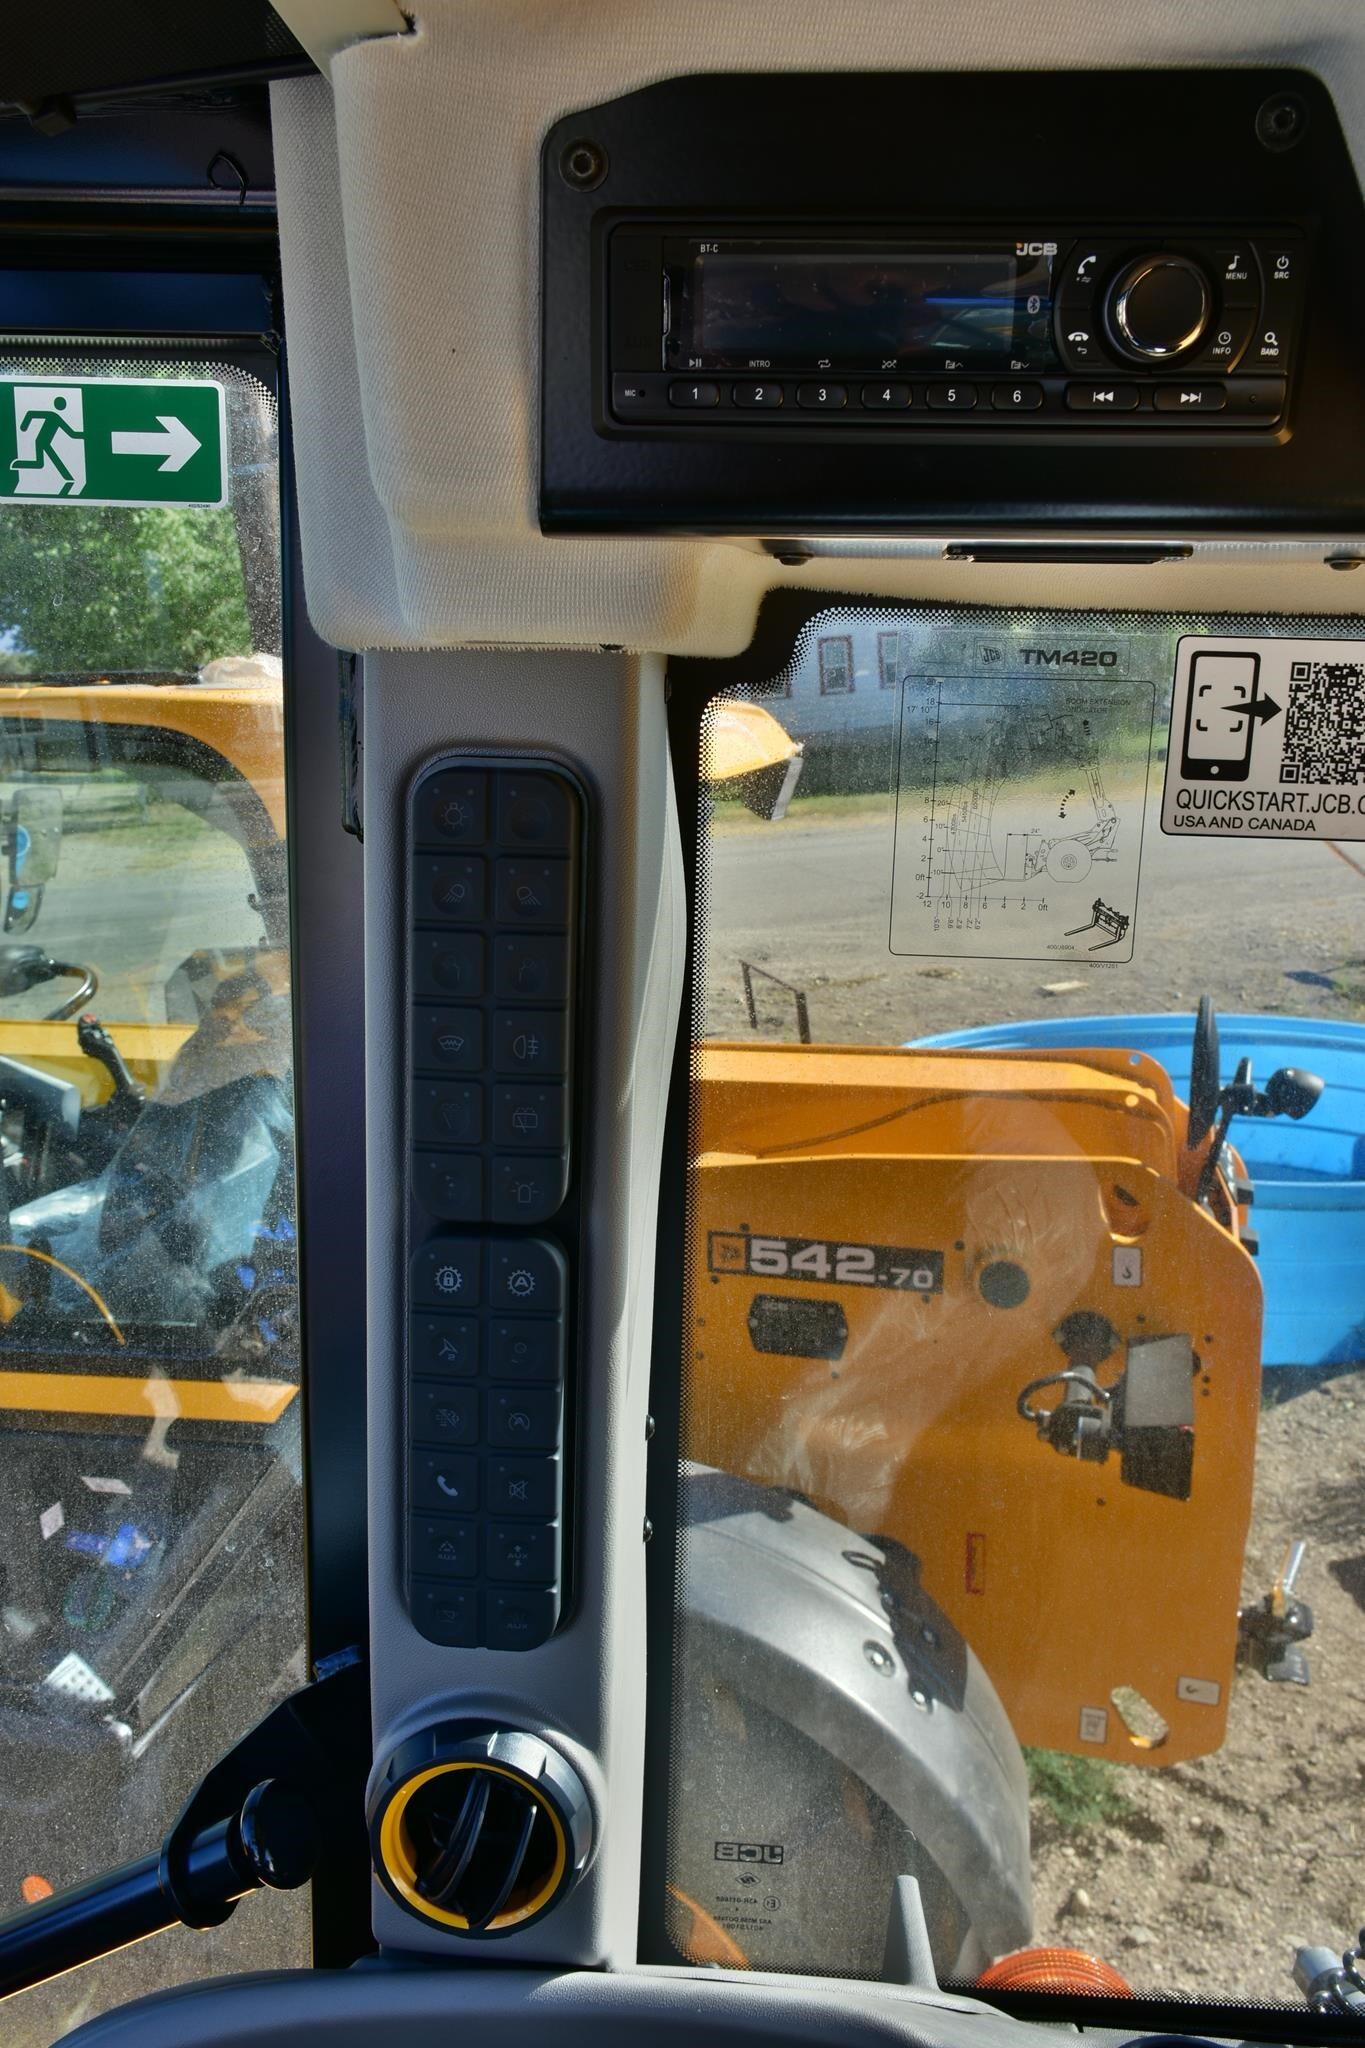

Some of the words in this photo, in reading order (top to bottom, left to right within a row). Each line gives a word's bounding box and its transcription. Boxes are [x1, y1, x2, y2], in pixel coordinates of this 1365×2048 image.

[1015, 242, 1058, 256] JCB
[1225, 271, 1247, 280] MENU
[1273, 271, 1289, 280] SRC
[1212, 346, 1231, 355] INFO
[1260, 347, 1279, 356] BAND
[749, 360, 771, 368] INTRO
[624, 389, 636, 397] MIC
[692, 388, 699, 400] 1
[755, 388, 763, 400] 2
[818, 389, 827, 401] 3
[882, 389, 891, 401] 4
[947, 389, 956, 402] 5
[1013, 390, 1021, 402] 6
[1020, 649, 1118, 667] TM420
[926, 697, 935, 705] 18
[1173, 815, 1206, 828] USA
[1208, 816, 1244, 829] AND
[1248, 817, 1316, 832] CANADA
[915, 873, 925, 881] 0ft
[923, 900, 932, 908] 12
[941, 901, 951, 909] 10
[1037, 903, 1048, 911] 0ft
